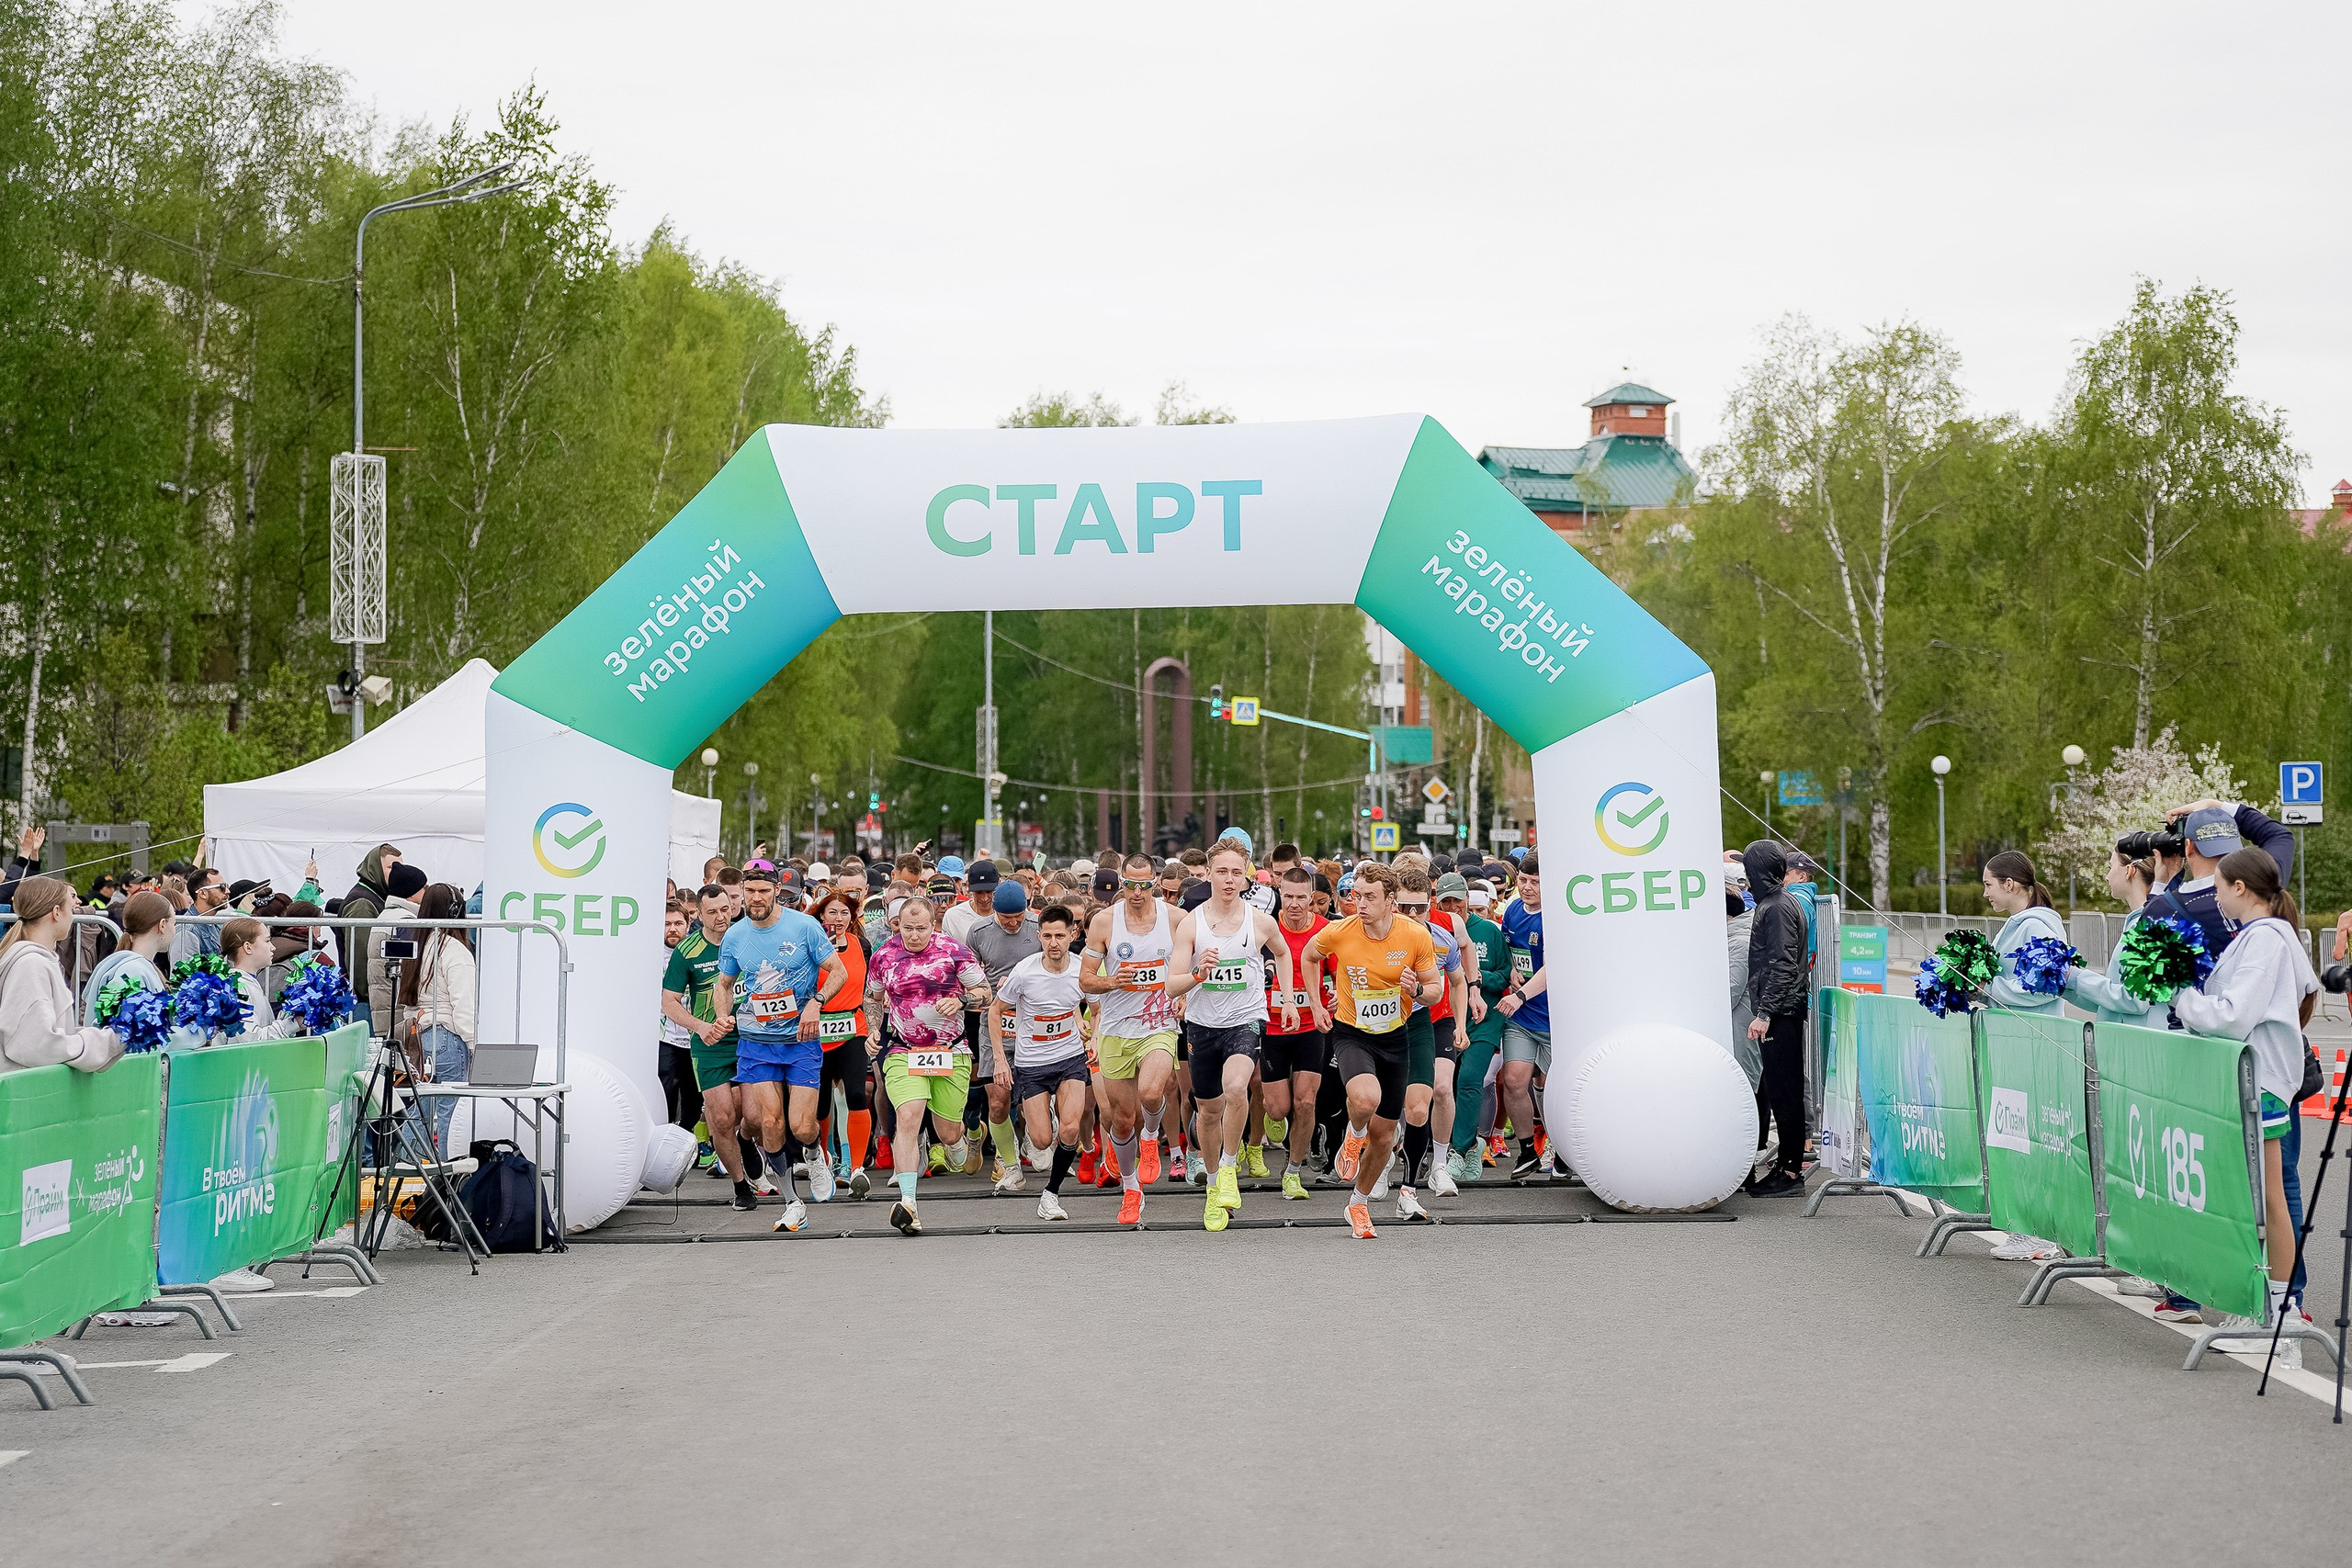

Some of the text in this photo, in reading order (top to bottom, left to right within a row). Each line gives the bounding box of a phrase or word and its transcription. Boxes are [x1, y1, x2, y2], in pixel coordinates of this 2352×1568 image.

[926, 479, 1262, 558] СТАРТ
[603, 537, 742, 677] зелёный
[1445, 529, 1596, 658] зелёный
[627, 570, 766, 704] марафон
[1420, 555, 1566, 684] марафон
[2292, 767, 2315, 800] P
[1566, 870, 1706, 916] СБЕР
[500, 891, 639, 937] СБЕР
[1133, 969, 1157, 982] 238
[1208, 968, 1243, 981] 1415
[762, 999, 787, 1013] 123
[1361, 1001, 1396, 1019] 4003
[821, 1020, 852, 1034] 1221
[1046, 1021, 1061, 1033] 81
[917, 1054, 944, 1066] 241
[1897, 1098, 1923, 1121] твоём
[1901, 1122, 1946, 1161] ритме
[94, 1148, 125, 1183] зелёный
[202, 1160, 246, 1192] В твоём
[2161, 1126, 2207, 1213] 185
[35, 1182, 64, 1223] Прайм
[87, 1181, 121, 1217] марафон
[214, 1182, 276, 1237] ритме
